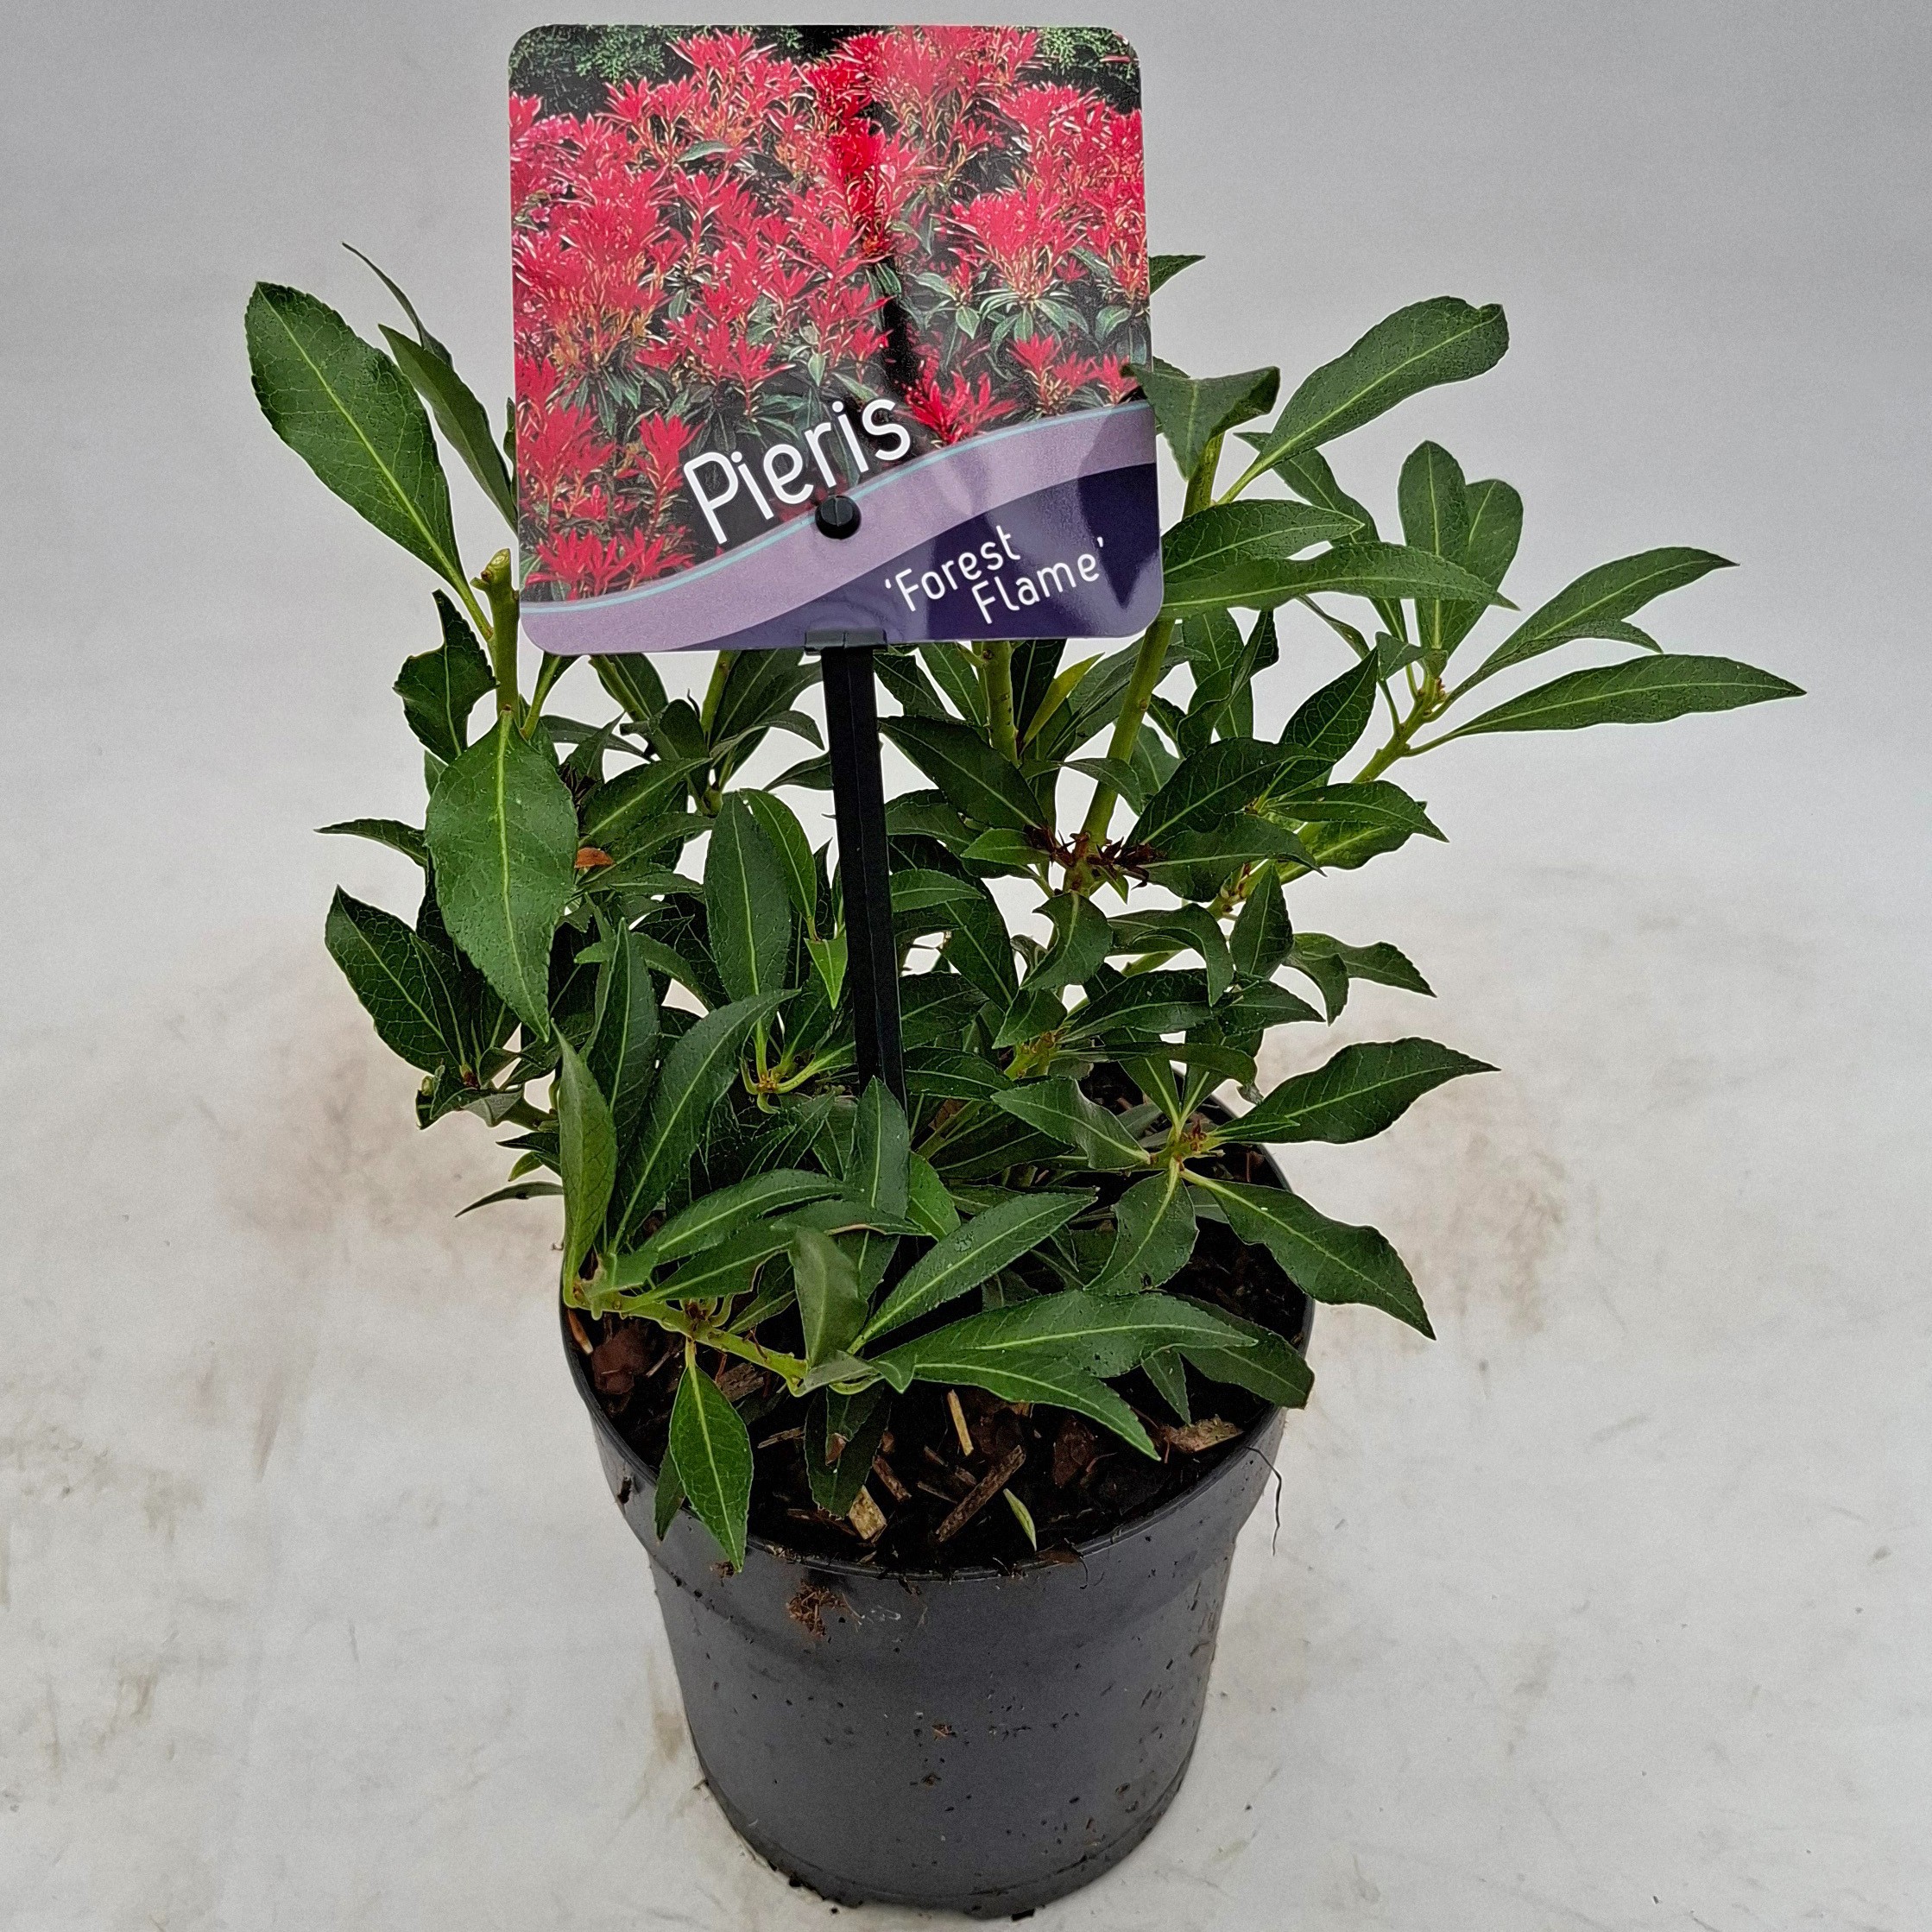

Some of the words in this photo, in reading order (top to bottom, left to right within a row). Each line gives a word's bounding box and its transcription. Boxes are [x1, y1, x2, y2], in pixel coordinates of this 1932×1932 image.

[684, 399, 911, 544] Pieris
[885, 525, 1020, 612] 'Forest
[971, 537, 1105, 624] Flame'
